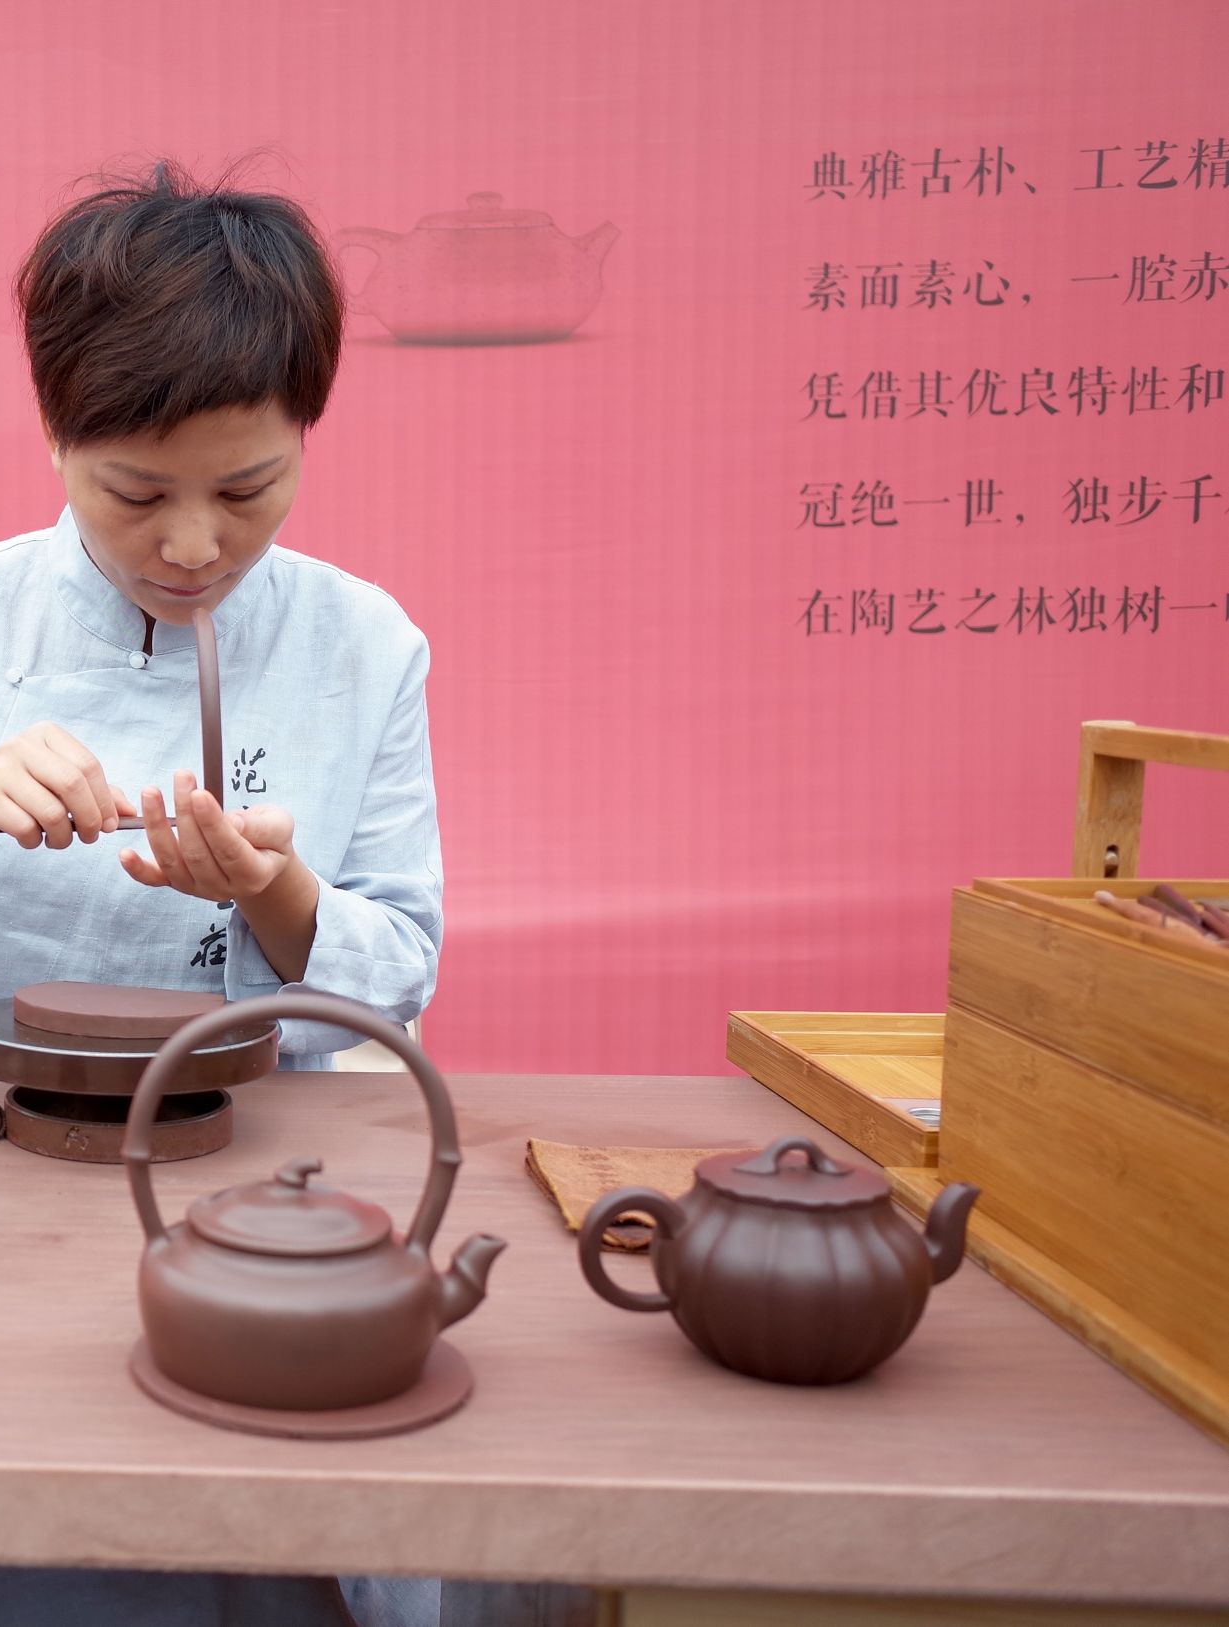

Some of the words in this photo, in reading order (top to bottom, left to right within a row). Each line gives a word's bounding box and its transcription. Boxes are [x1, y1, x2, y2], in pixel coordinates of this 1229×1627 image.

[799, 363, 1225, 423] 凭借其优良特性和
[795, 474, 1229, 531] 冠绝一世，独步千
[795, 585, 1229, 638] 在陶艺之林独树一
